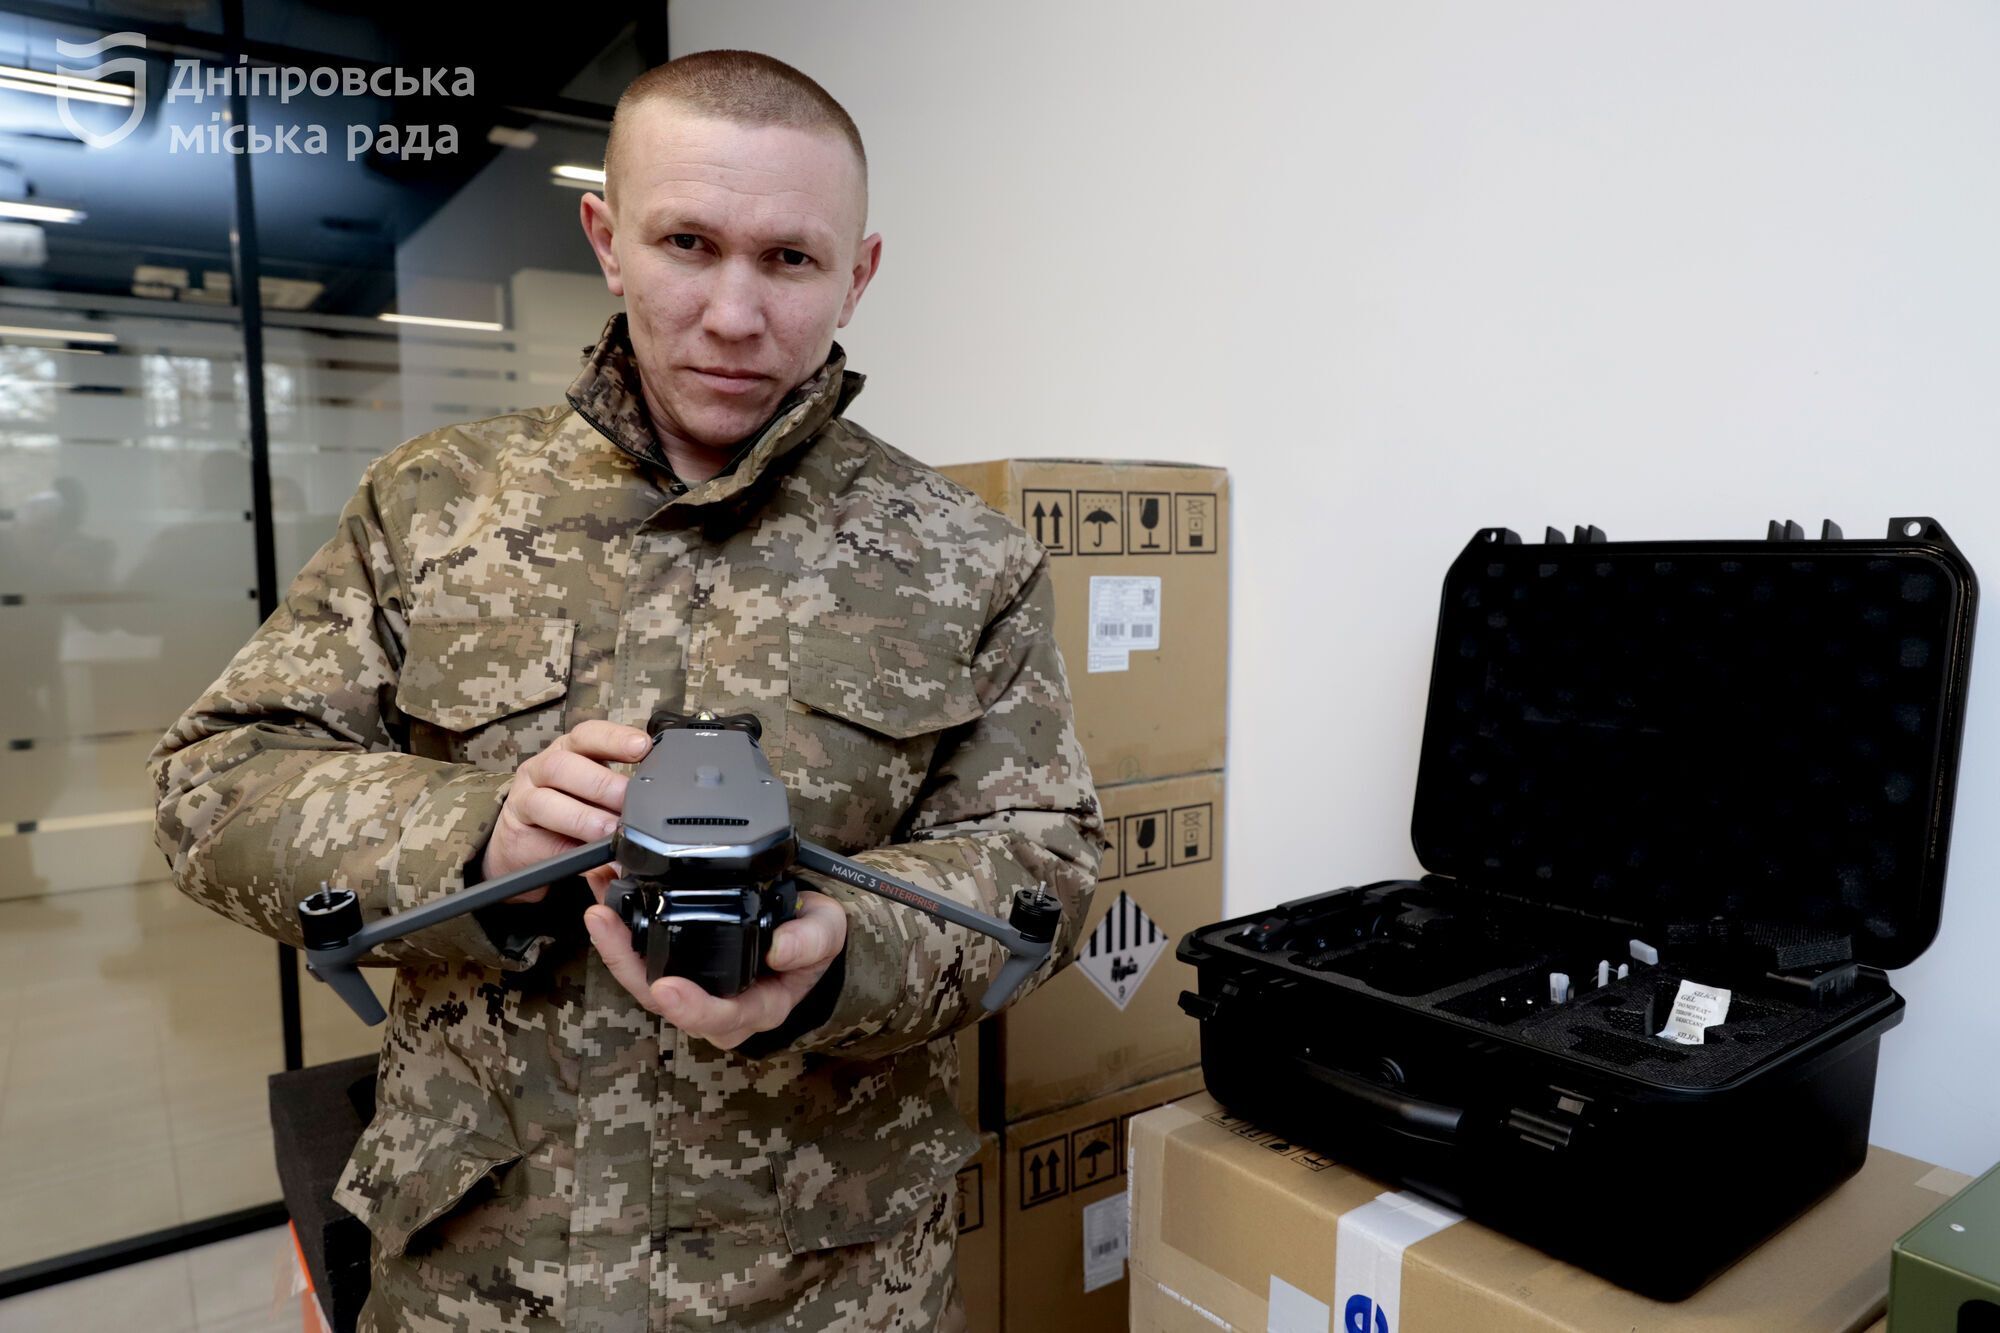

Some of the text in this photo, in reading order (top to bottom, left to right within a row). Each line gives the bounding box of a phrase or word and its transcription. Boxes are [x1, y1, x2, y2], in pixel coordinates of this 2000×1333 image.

[831, 863, 940, 912] MAVIC 3 ENTERPRISE
[1680, 994, 1696, 1002] GEL
